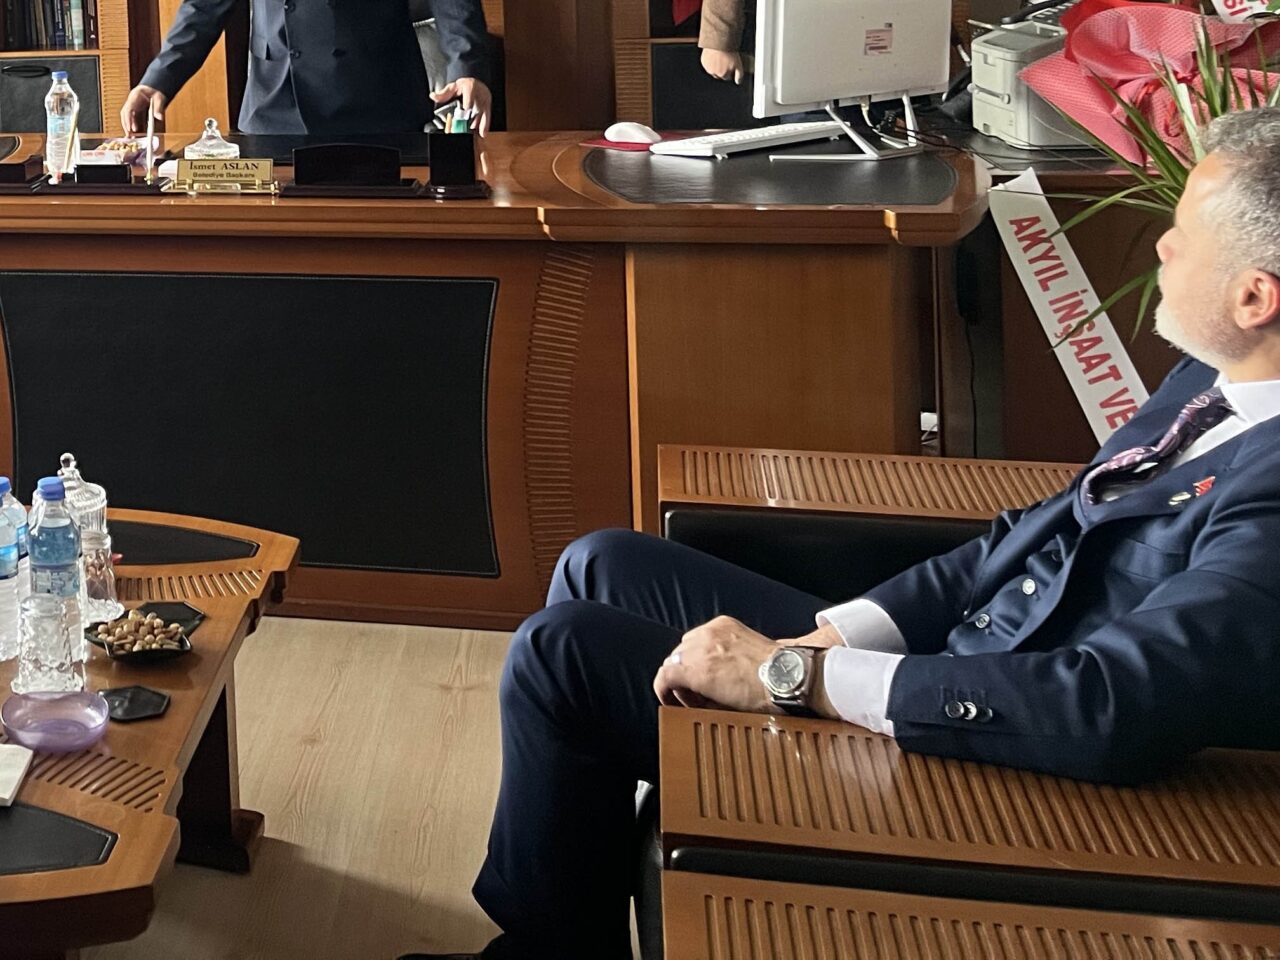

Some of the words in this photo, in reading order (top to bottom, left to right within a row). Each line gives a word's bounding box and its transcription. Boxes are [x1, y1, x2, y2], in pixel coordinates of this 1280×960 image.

[189, 161, 216, 171] İsmet
[220, 162, 260, 171] ASLAN
[1009, 215, 1070, 293] AKYIL
[1048, 288, 1124, 386] İNŞAAT
